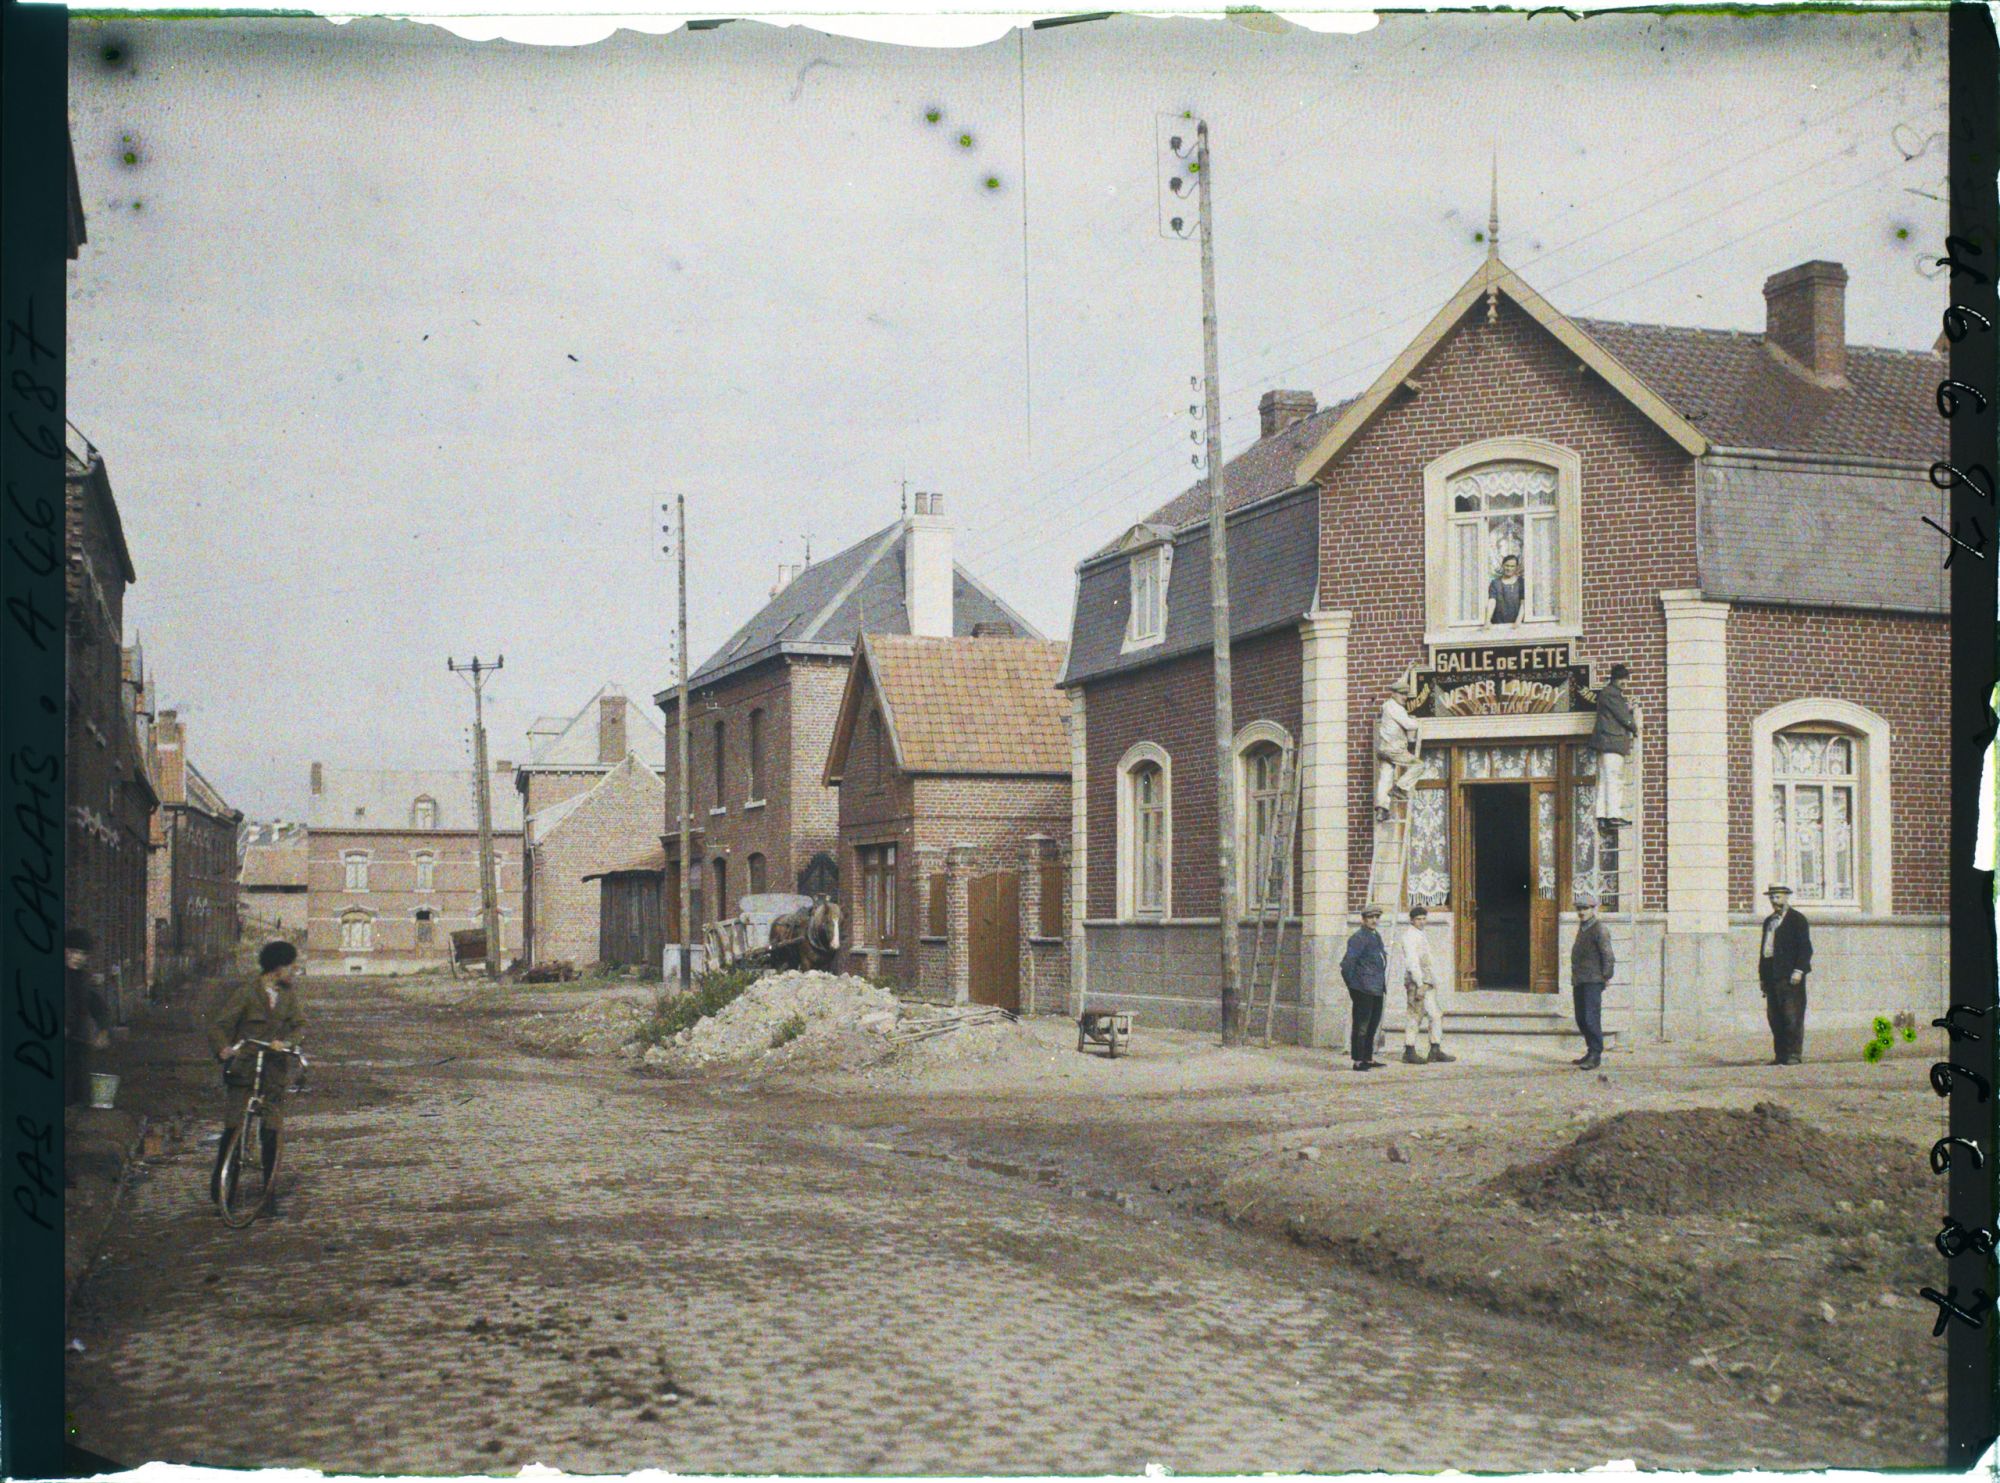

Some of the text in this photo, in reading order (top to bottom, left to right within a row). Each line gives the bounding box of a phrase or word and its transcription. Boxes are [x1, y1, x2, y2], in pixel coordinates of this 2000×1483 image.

[1437, 650, 1495, 673] SALLE
[1520, 646, 1568, 669] FÊTE
[1501, 679, 1567, 703] LANCRY
[1407, 682, 1430, 714] INEMA
[10, 744, 60, 954] CALAIS
[13, 967, 58, 1081] DE
[13, 1113, 58, 1231] PAS
